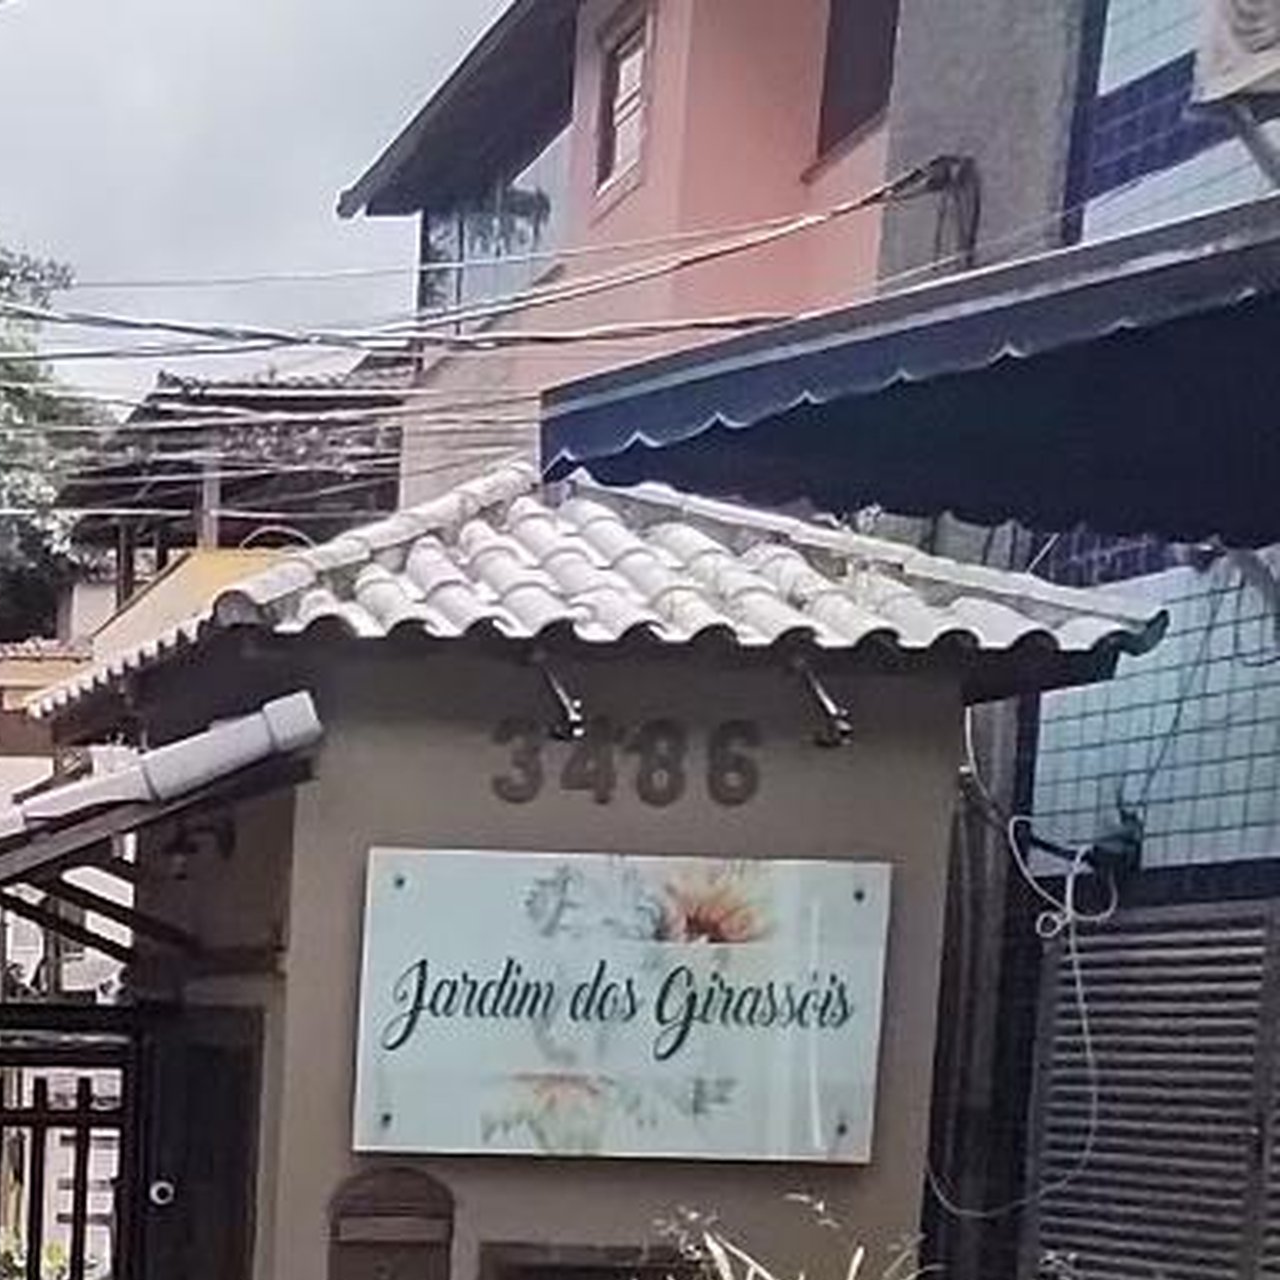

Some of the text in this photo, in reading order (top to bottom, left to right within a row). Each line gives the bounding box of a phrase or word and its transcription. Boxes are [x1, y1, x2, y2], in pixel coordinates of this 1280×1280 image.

[491, 716, 760, 807] 3486
[381, 958, 856, 1061] Jardim dos Girassóis
